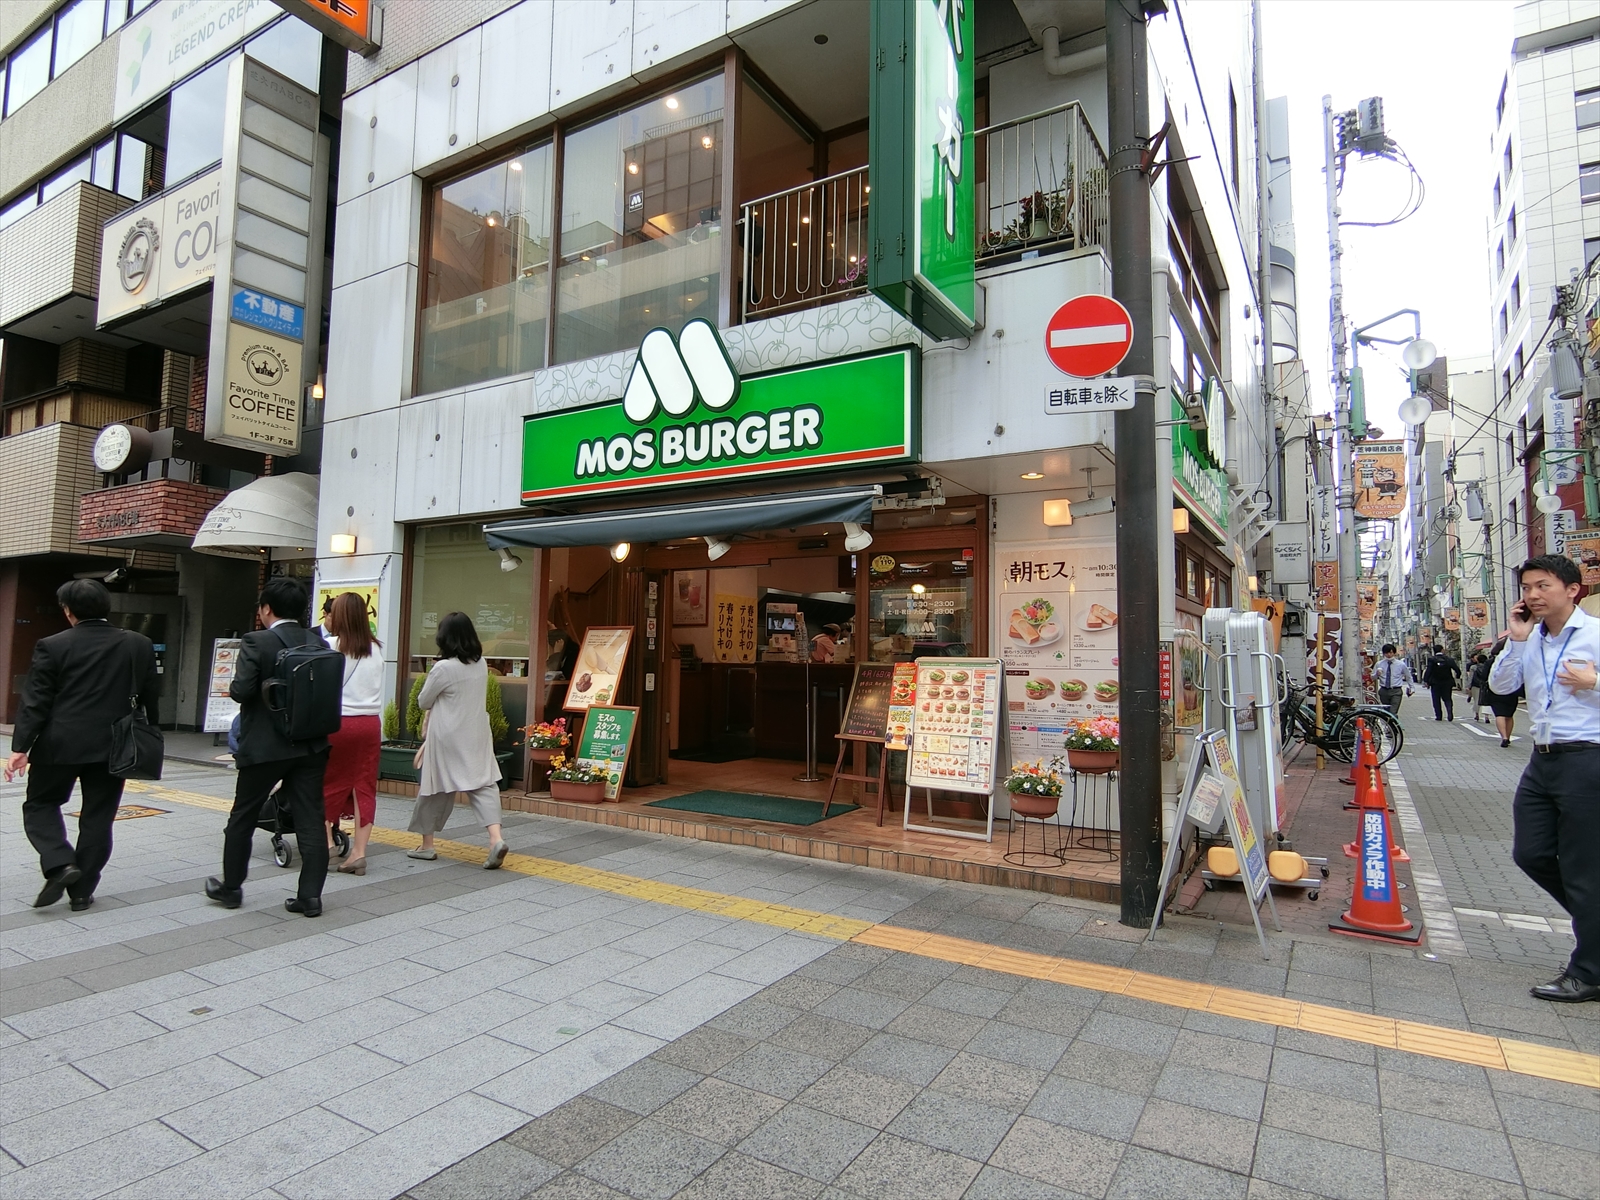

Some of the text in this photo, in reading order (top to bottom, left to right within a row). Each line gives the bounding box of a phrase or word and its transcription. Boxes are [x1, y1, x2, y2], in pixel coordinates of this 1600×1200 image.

[168, 22, 216, 66] LEGEND
[218, 0, 262, 31] CREA
[243, 290, 296, 324] 不動産
[240, 344, 262, 363] premium
[262, 344, 277, 354] cafe
[280, 358, 290, 373] BAR
[228, 394, 296, 423] COFFEE
[229, 381, 297, 407] Favorite Time
[1049, 385, 1129, 407] 自転車を除く
[575, 407, 821, 476] MOS BURGER
[1182, 445, 1199, 495] MOS
[1010, 561, 1069, 583] 朝モス
[717, 602, 726, 650] テリヤキ
[725, 602, 734, 650] 春だけの
[738, 605, 747, 651] テリヤキ
[746, 604, 755, 651] 春だけの
[1162, 654, 1171, 697] 連結送水管
[595, 721, 622, 732] スタッフを
[597, 713, 616, 723] モスの
[1364, 812, 1387, 890] 防犯カメラ作動中
